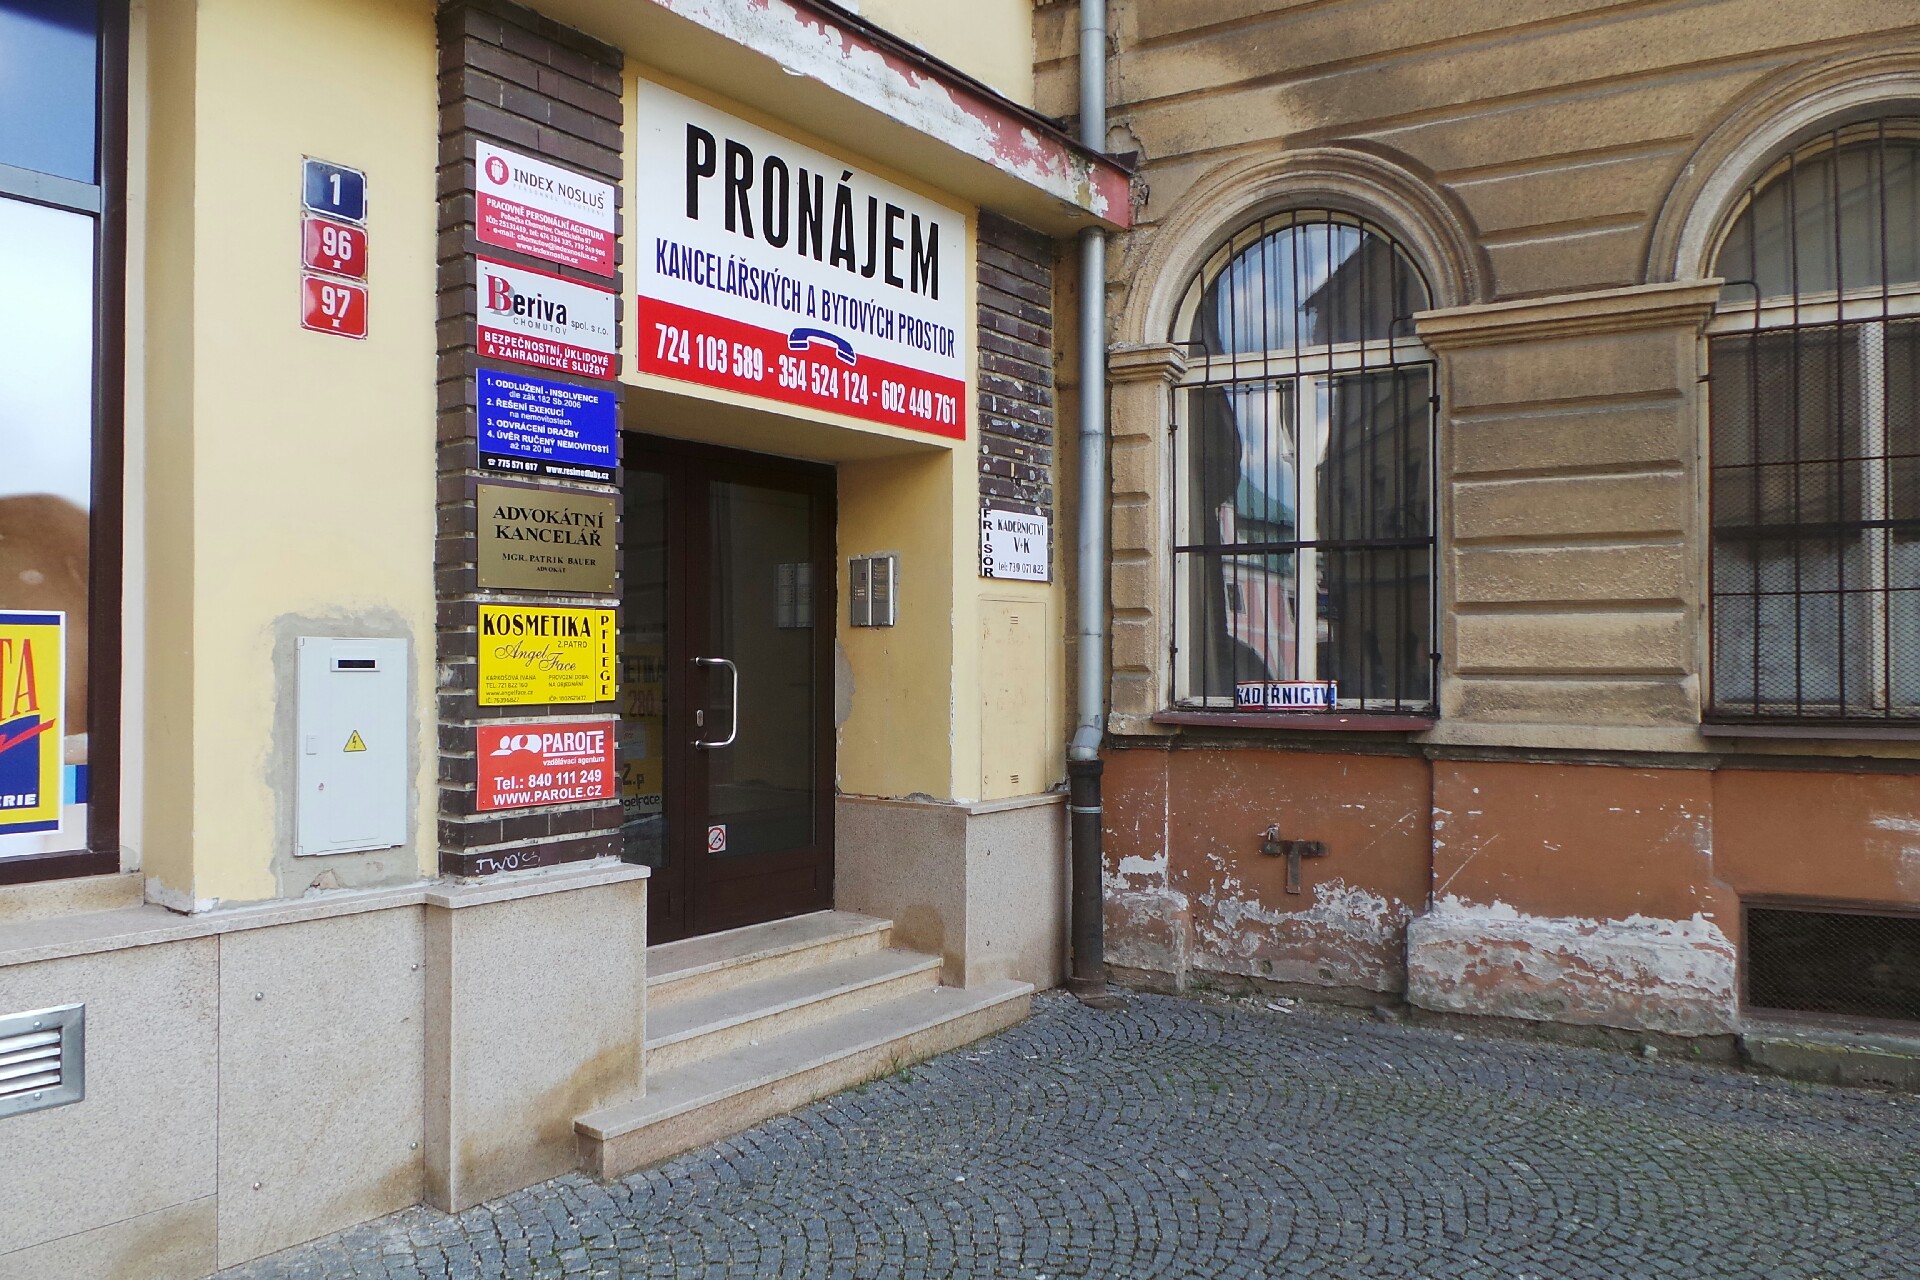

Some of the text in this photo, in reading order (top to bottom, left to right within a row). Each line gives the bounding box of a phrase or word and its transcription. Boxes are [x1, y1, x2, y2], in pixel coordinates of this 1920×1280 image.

[329, 173, 341, 206] 1
[513, 168, 605, 210] INDEX NOSLUŠ
[500, 212, 525, 225] Pobočka
[686, 122, 939, 301] PRONÁJEM
[526, 209, 570, 230] PERSONÁLNÍ
[570, 223, 605, 242] AGENTURA
[322, 226, 352, 261] 96
[515, 241, 579, 264] www.indexnoslus.cz
[321, 284, 351, 318] 97
[484, 273, 567, 326] Beriva
[656, 237, 956, 360] KANCELÁŘSKÝCH A BYTOVÝCH PROSTOR
[513, 317, 609, 336] CHOMUTOV spol. s r.o.
[484, 331, 609, 367] BEZPEČNOSTNÍ, ÚKLIDOVÉ
[487, 344, 606, 376] A ZAHRADNICKÉ SLUŽBY
[655, 322, 691, 366] 724
[695, 332, 728, 374] 103
[732, 344, 763, 382] 589
[778, 353, 807, 391] 354
[811, 361, 839, 399] 524
[843, 370, 869, 406] 124
[881, 379, 905, 414] 602
[909, 386, 932, 420] 449
[934, 393, 957, 426] 761
[486, 378, 494, 386] 1.
[495, 379, 544, 395] ODDLUŽENÍ
[549, 389, 599, 404] INSOLVENCE
[508, 390, 521, 399] dle
[486, 397, 564, 417] 2. ŘEŠENÍ EXEKUCÍ
[509, 411, 573, 425] na nemovitostech
[487, 418, 580, 439] 3. ODVRÁCENÍ DRAŽBY
[486, 429, 609, 454] 4. ÚVĚR RUČENÝ NEMOVITOSTÍ
[509, 442, 520, 450] až
[532, 444, 542, 453] 20
[543, 446, 553, 454] let
[497, 458, 511, 468] 775
[511, 460, 524, 470] 571
[524, 461, 538, 471] 617
[492, 505, 604, 529] ADVOKÁTNÍ
[997, 518, 1044, 536] KADEŘNICTVÍ
[495, 524, 602, 547] KANCELÁŘ
[982, 509, 994, 577] FRISÖR
[1013, 536, 1030, 554] V+K
[502, 552, 597, 567] MGR. PATRIK BAUER
[1009, 562, 1021, 573] 739
[1021, 563, 1032, 574] 071
[1032, 564, 1044, 575] 822
[483, 613, 591, 638] KOSMETIKA
[494, 639, 550, 667] Angel
[557, 640, 588, 649] 2.PATRO
[599, 615, 611, 696] PFLEGE
[538, 652, 577, 672] Face
[543, 730, 605, 756] PAROLE
[542, 756, 605, 767] vzdělávací agentura
[494, 769, 602, 791] Tel.: 840 111 249
[0, 794, 37, 806] RIE
[493, 785, 602, 806] WWW.PAROLE.CZ
[620, 793, 662, 812] gelface.
